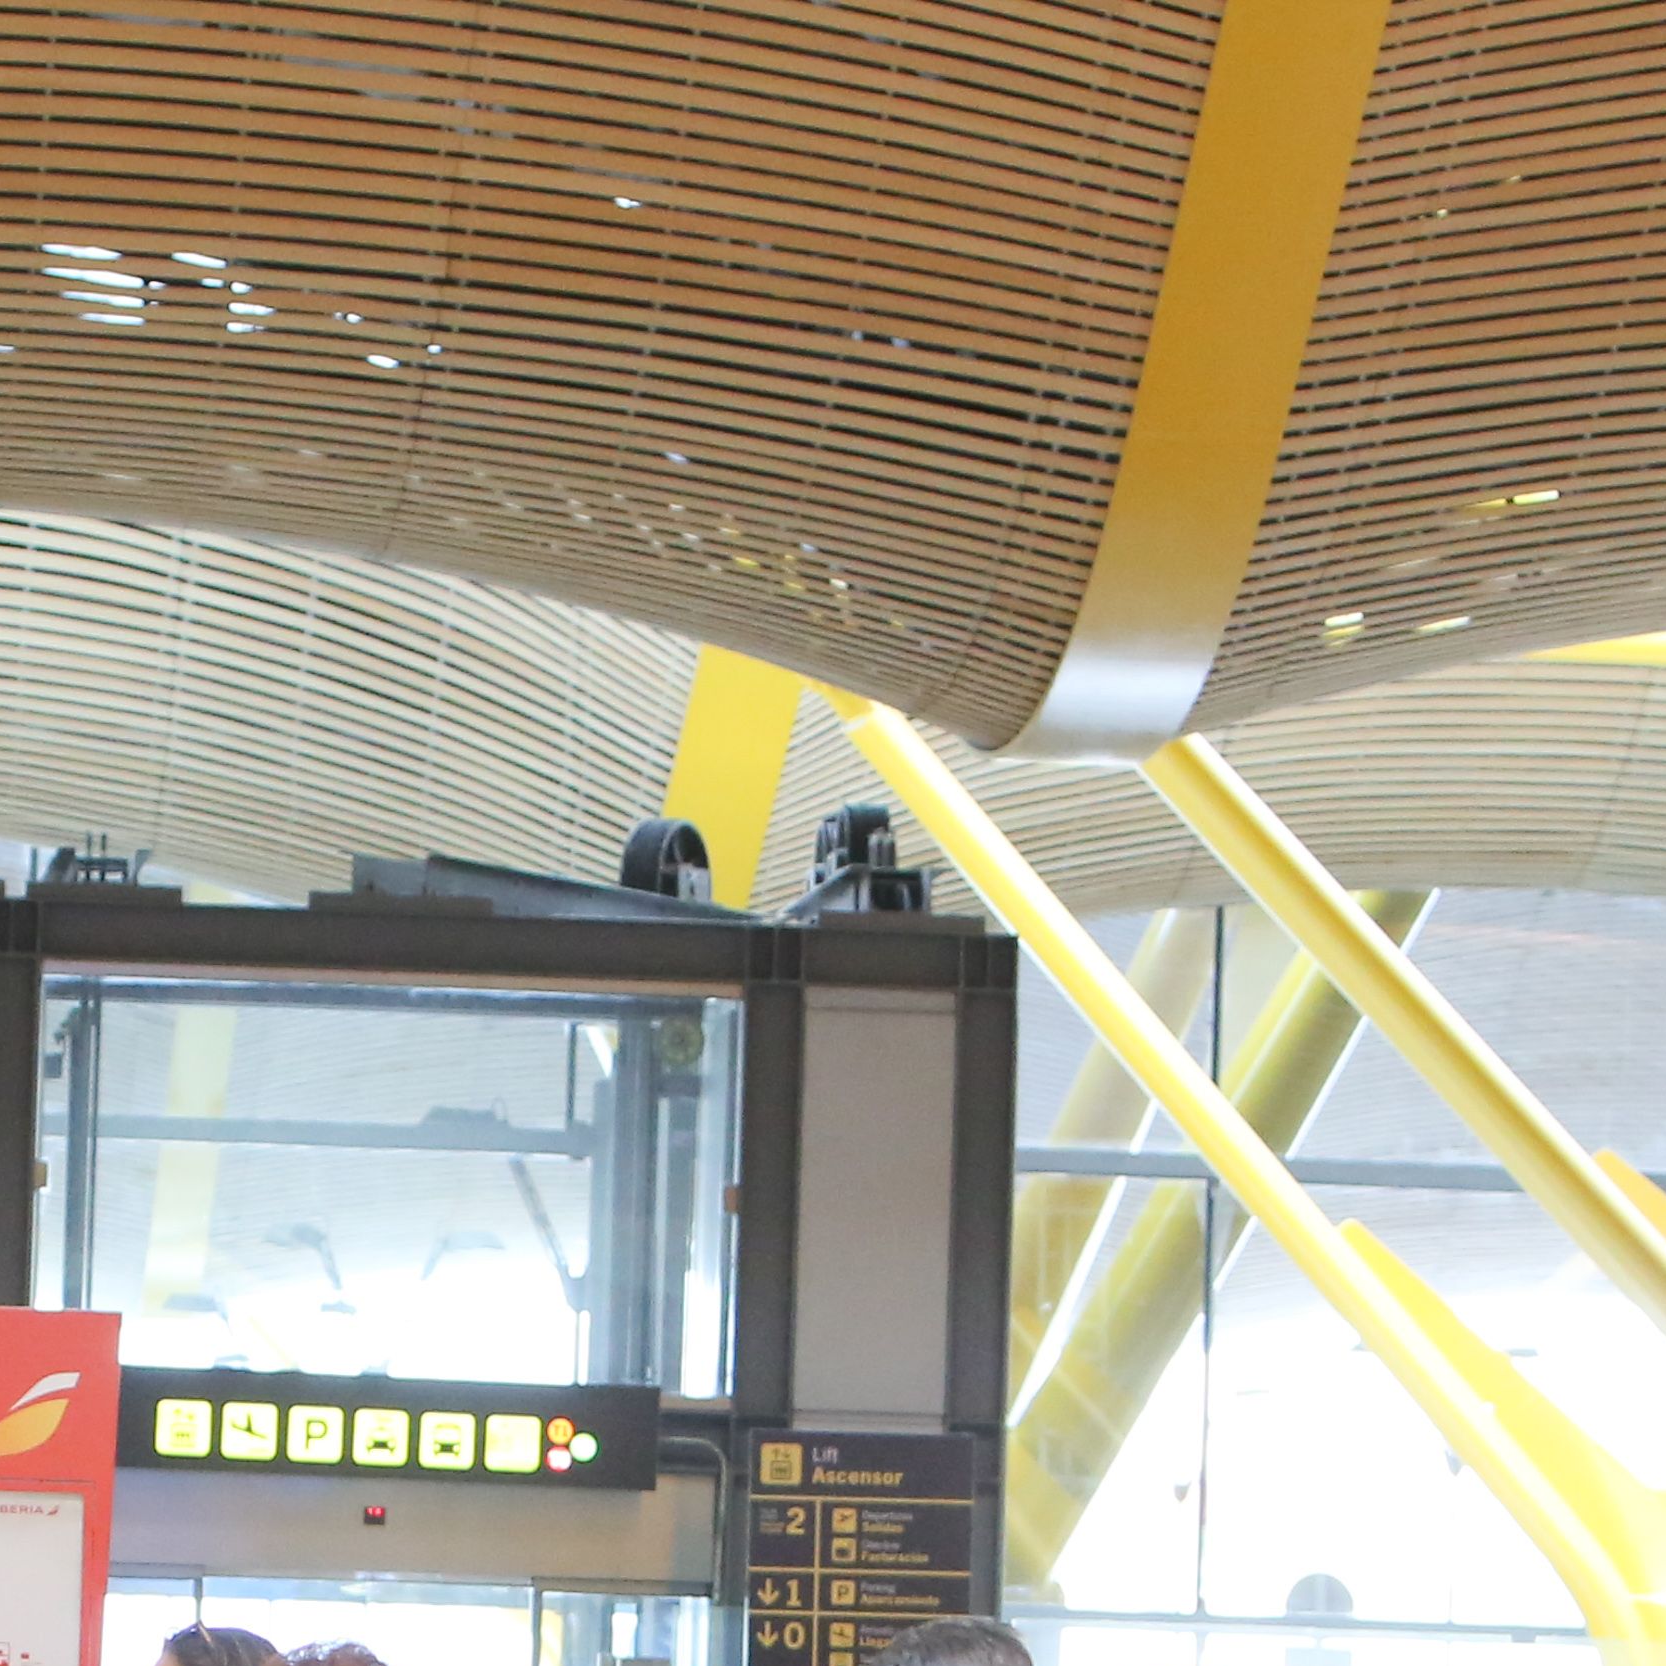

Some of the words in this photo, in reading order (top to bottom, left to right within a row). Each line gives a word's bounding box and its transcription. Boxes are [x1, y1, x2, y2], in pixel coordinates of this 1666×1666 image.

[811, 1446, 840, 1464] Lift
[811, 1466, 904, 1486] Ascensor
[785, 1506, 807, 1535] 2
[786, 1578, 802, 1607] 1
[784, 1621, 806, 1650] 0
